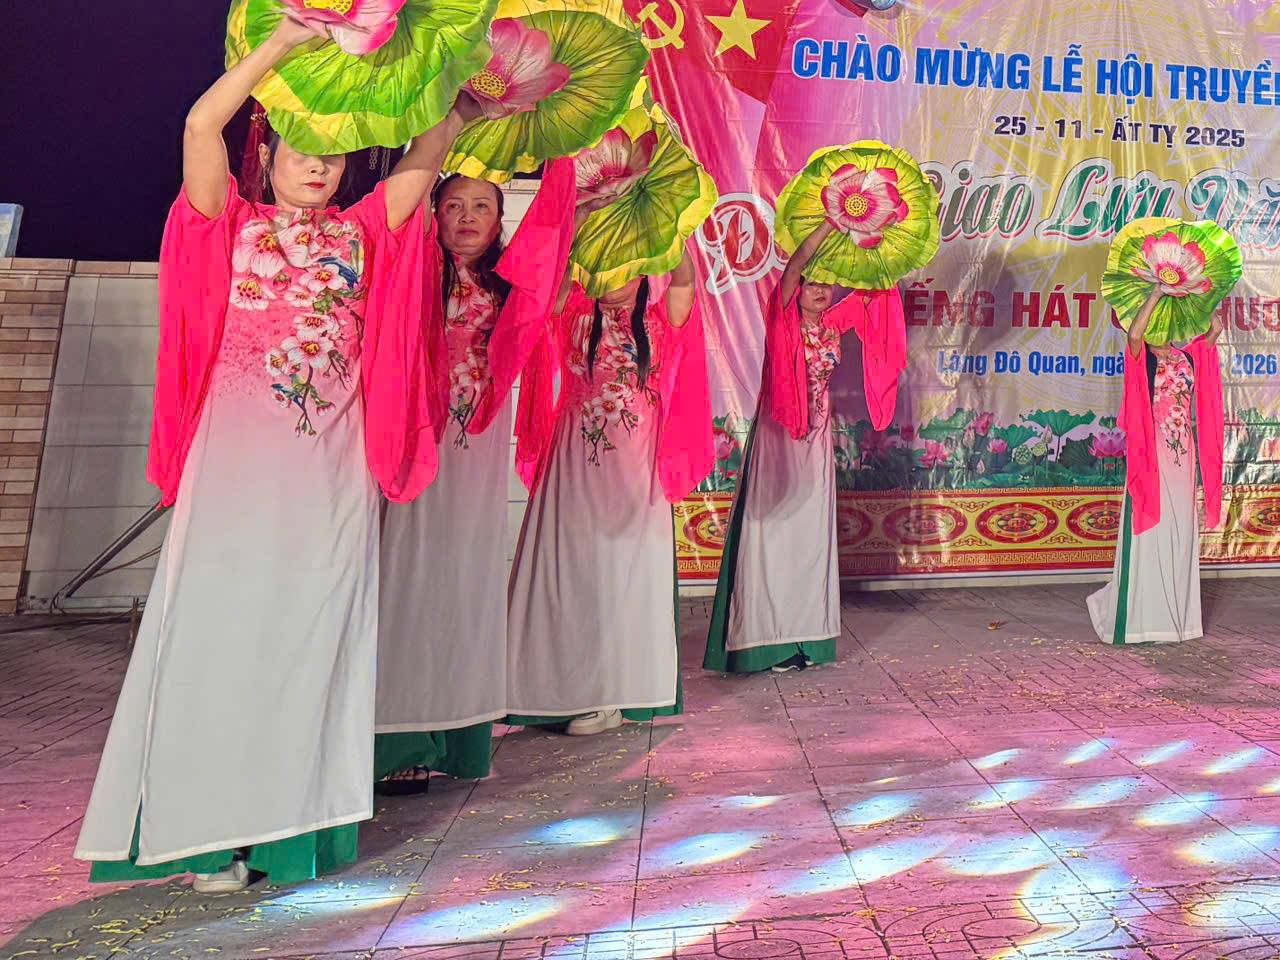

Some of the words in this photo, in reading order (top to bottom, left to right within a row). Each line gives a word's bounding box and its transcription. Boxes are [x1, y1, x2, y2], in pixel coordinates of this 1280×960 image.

[793, 34, 901, 82] CHÀO
[915, 41, 1031, 90] MỪNG
[1042, 44, 1083, 93] LỄ
[1096, 53, 1153, 105] HỘI
[994, 115, 1026, 136] 25
[1055, 119, 1082, 139] 11
[1111, 115, 1142, 142] ẤT
[1185, 126, 1246, 148] 2025
[904, 277, 995, 328] ẾNG
[1011, 284, 1097, 328] HÁT
[937, 350, 988, 376] Làng
[995, 351, 1021, 374] Đô
[1028, 351, 1086, 376] Quan,
[1092, 352, 1125, 377] ngà
[1231, 353, 1277, 375] 2026
